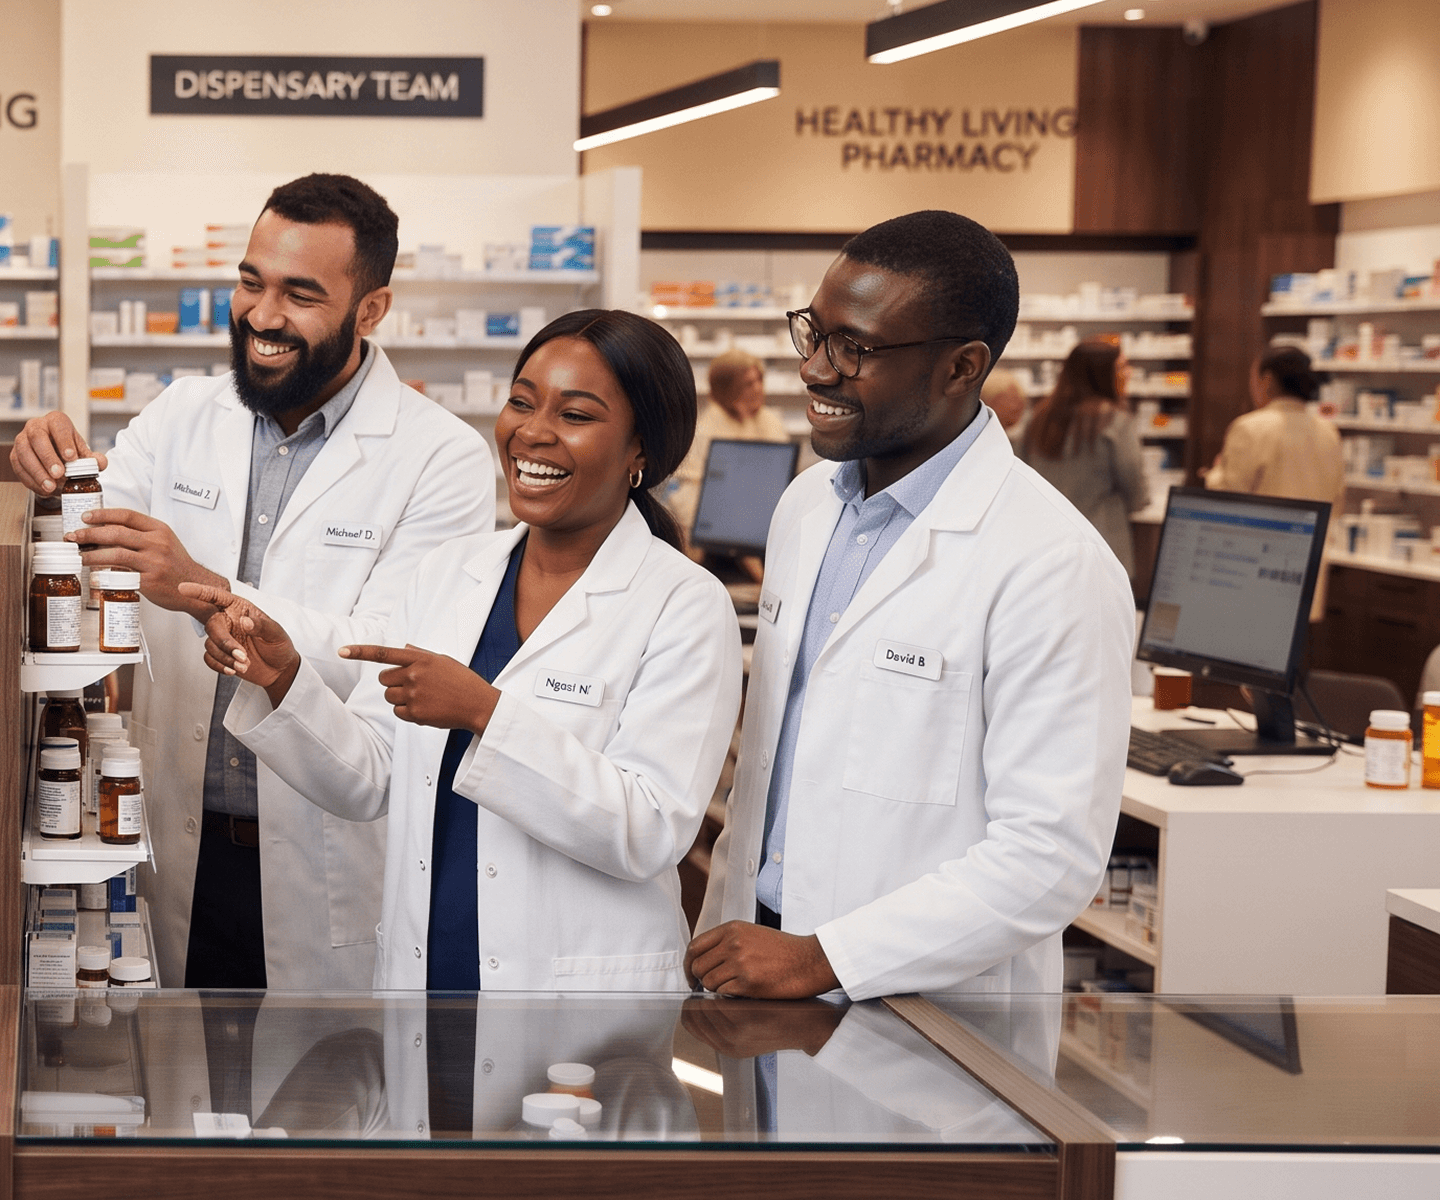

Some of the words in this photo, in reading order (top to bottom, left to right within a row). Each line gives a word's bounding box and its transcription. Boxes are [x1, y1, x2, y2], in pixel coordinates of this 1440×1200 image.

[174, 70, 366, 100] DISPENSARY
[369, 70, 459, 101] TEAM
[794, 106, 952, 137] HEALTHY
[962, 106, 1078, 138] LIVING
[841, 142, 1040, 172] PHARMACY
[918, 656, 926, 667] B
